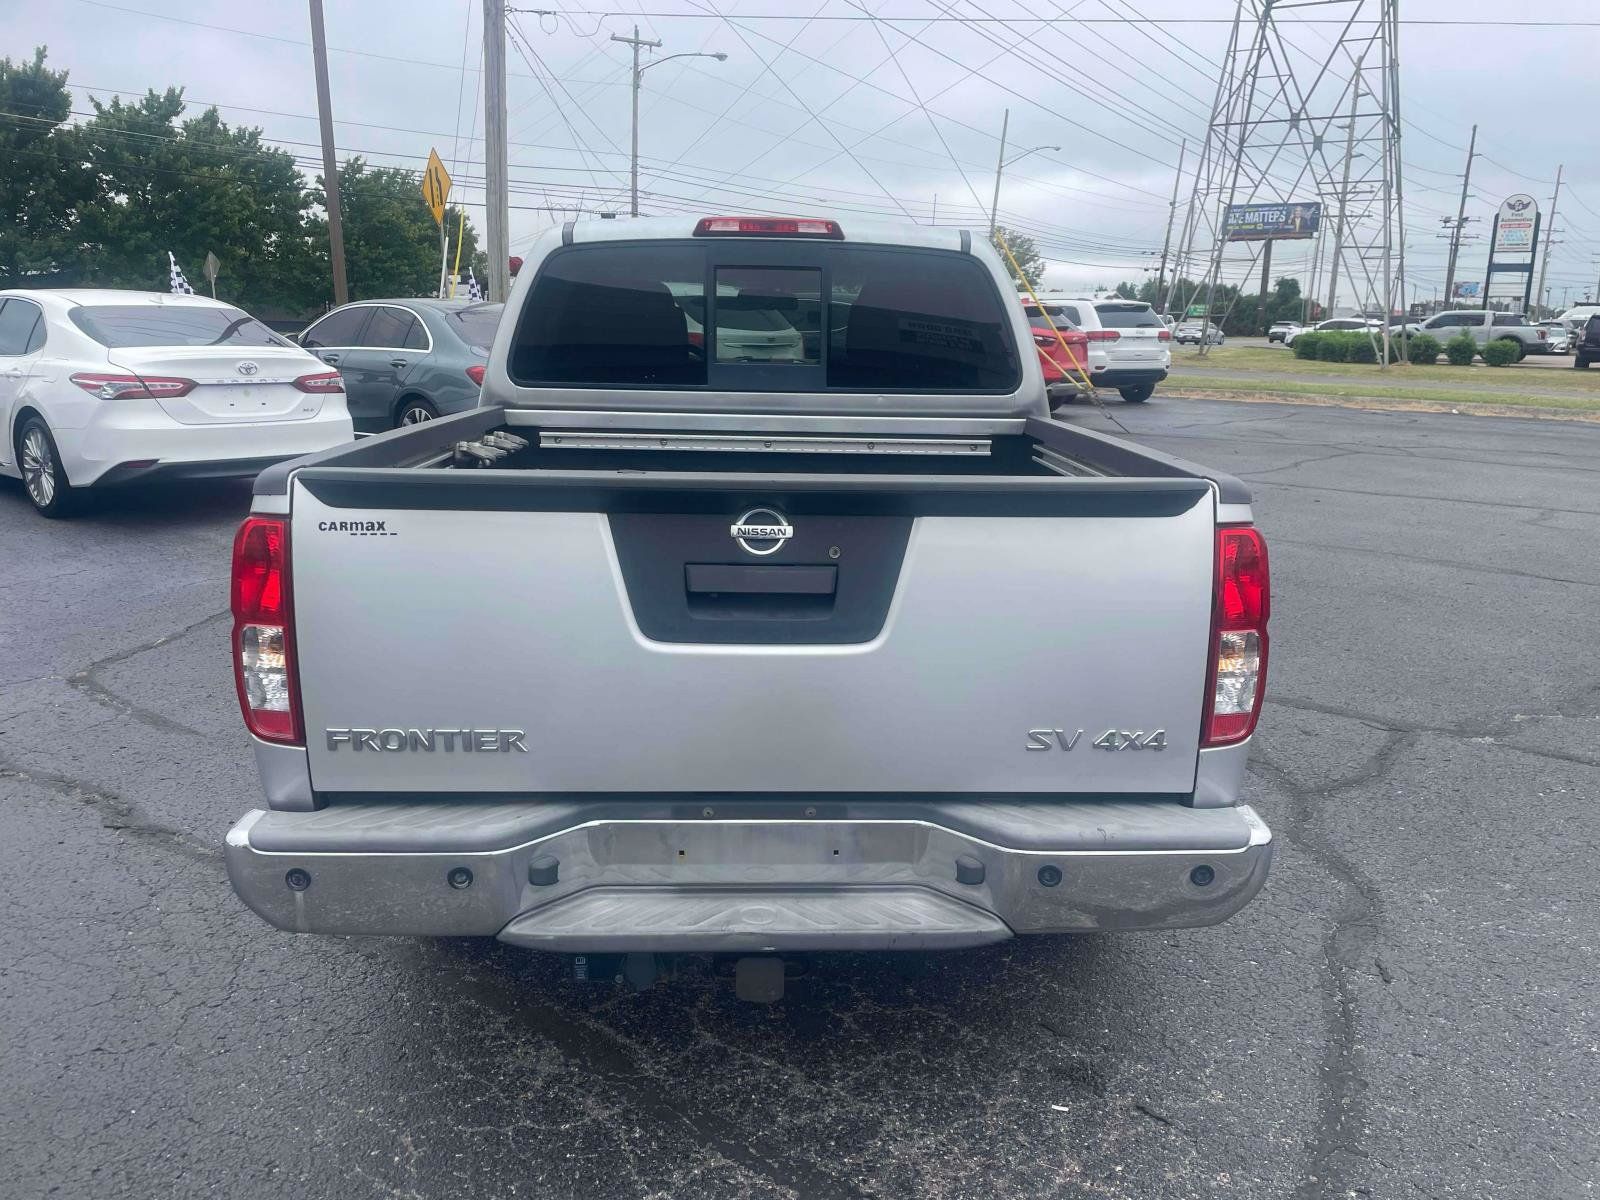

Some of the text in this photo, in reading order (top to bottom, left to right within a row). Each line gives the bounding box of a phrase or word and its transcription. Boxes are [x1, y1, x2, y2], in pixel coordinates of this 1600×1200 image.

[737, 527, 787, 537] NISSAN
[325, 728, 528, 752] FRONTIER
[1025, 728, 1084, 752] SV
